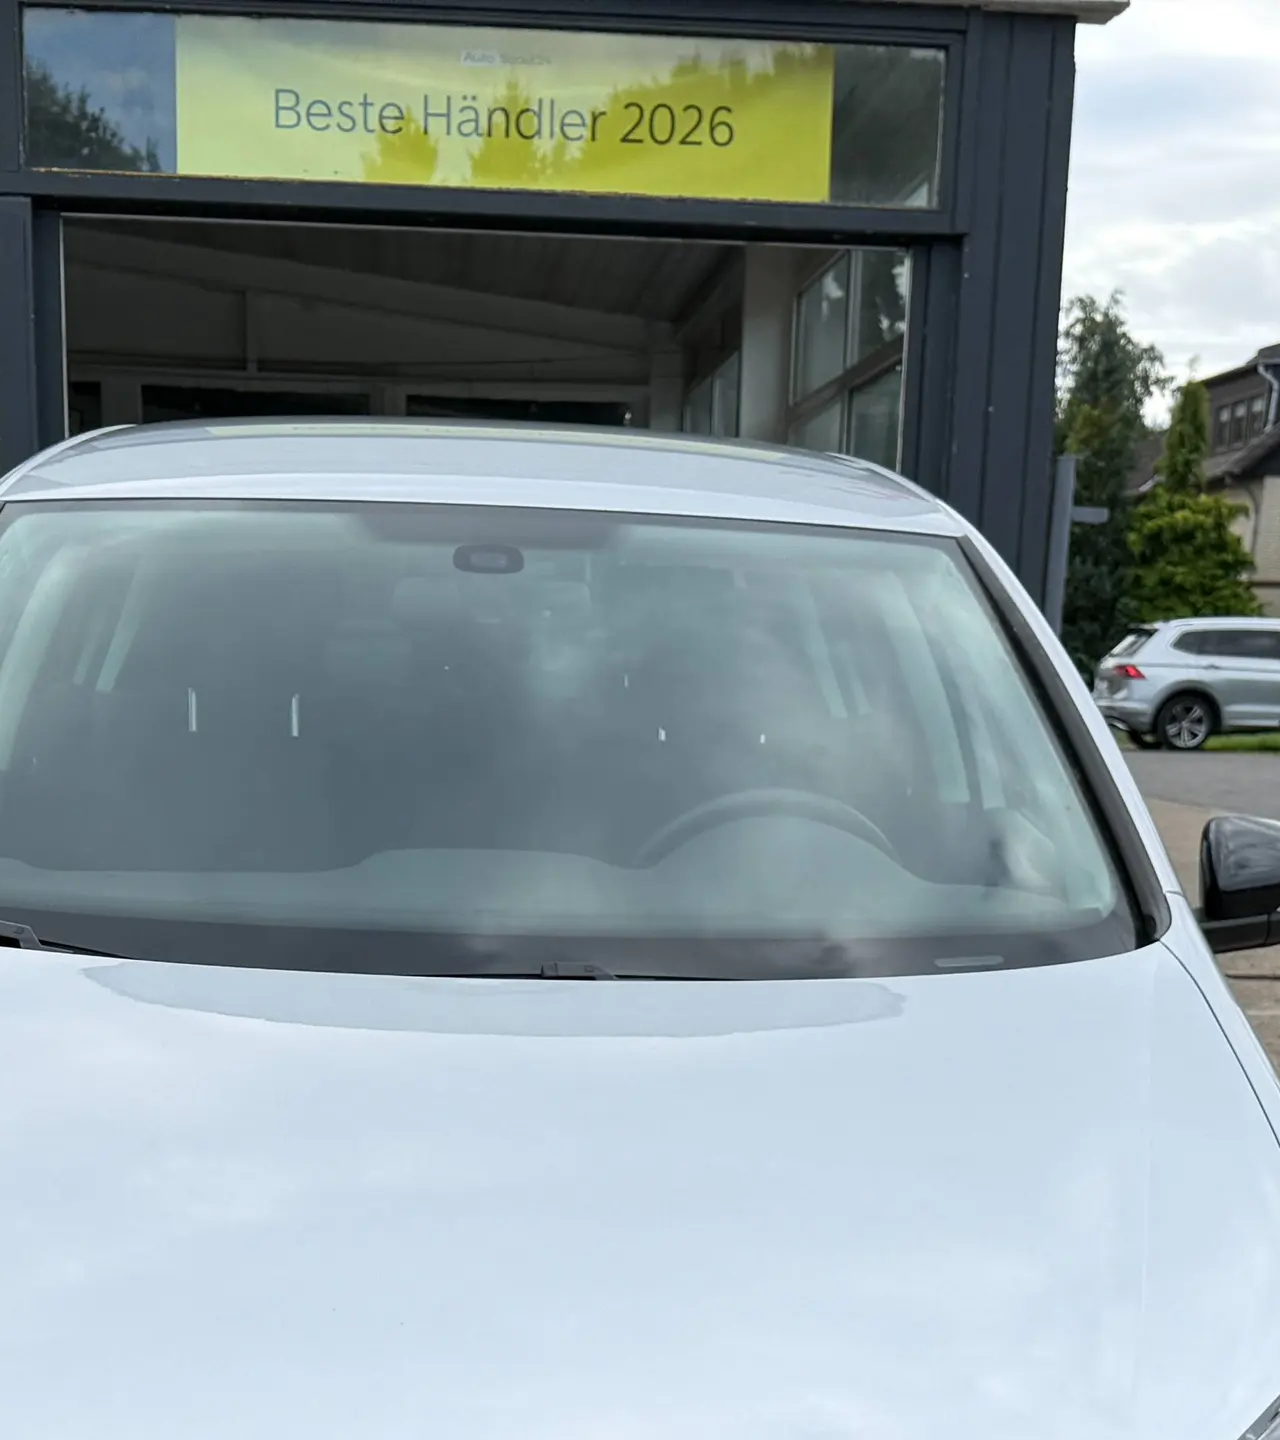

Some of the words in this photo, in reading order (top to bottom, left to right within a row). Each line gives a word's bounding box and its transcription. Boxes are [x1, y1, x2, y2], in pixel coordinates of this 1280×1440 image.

[274, 88, 405, 135] Beste
[423, 94, 608, 143] Händler
[620, 102, 735, 147] 2026
